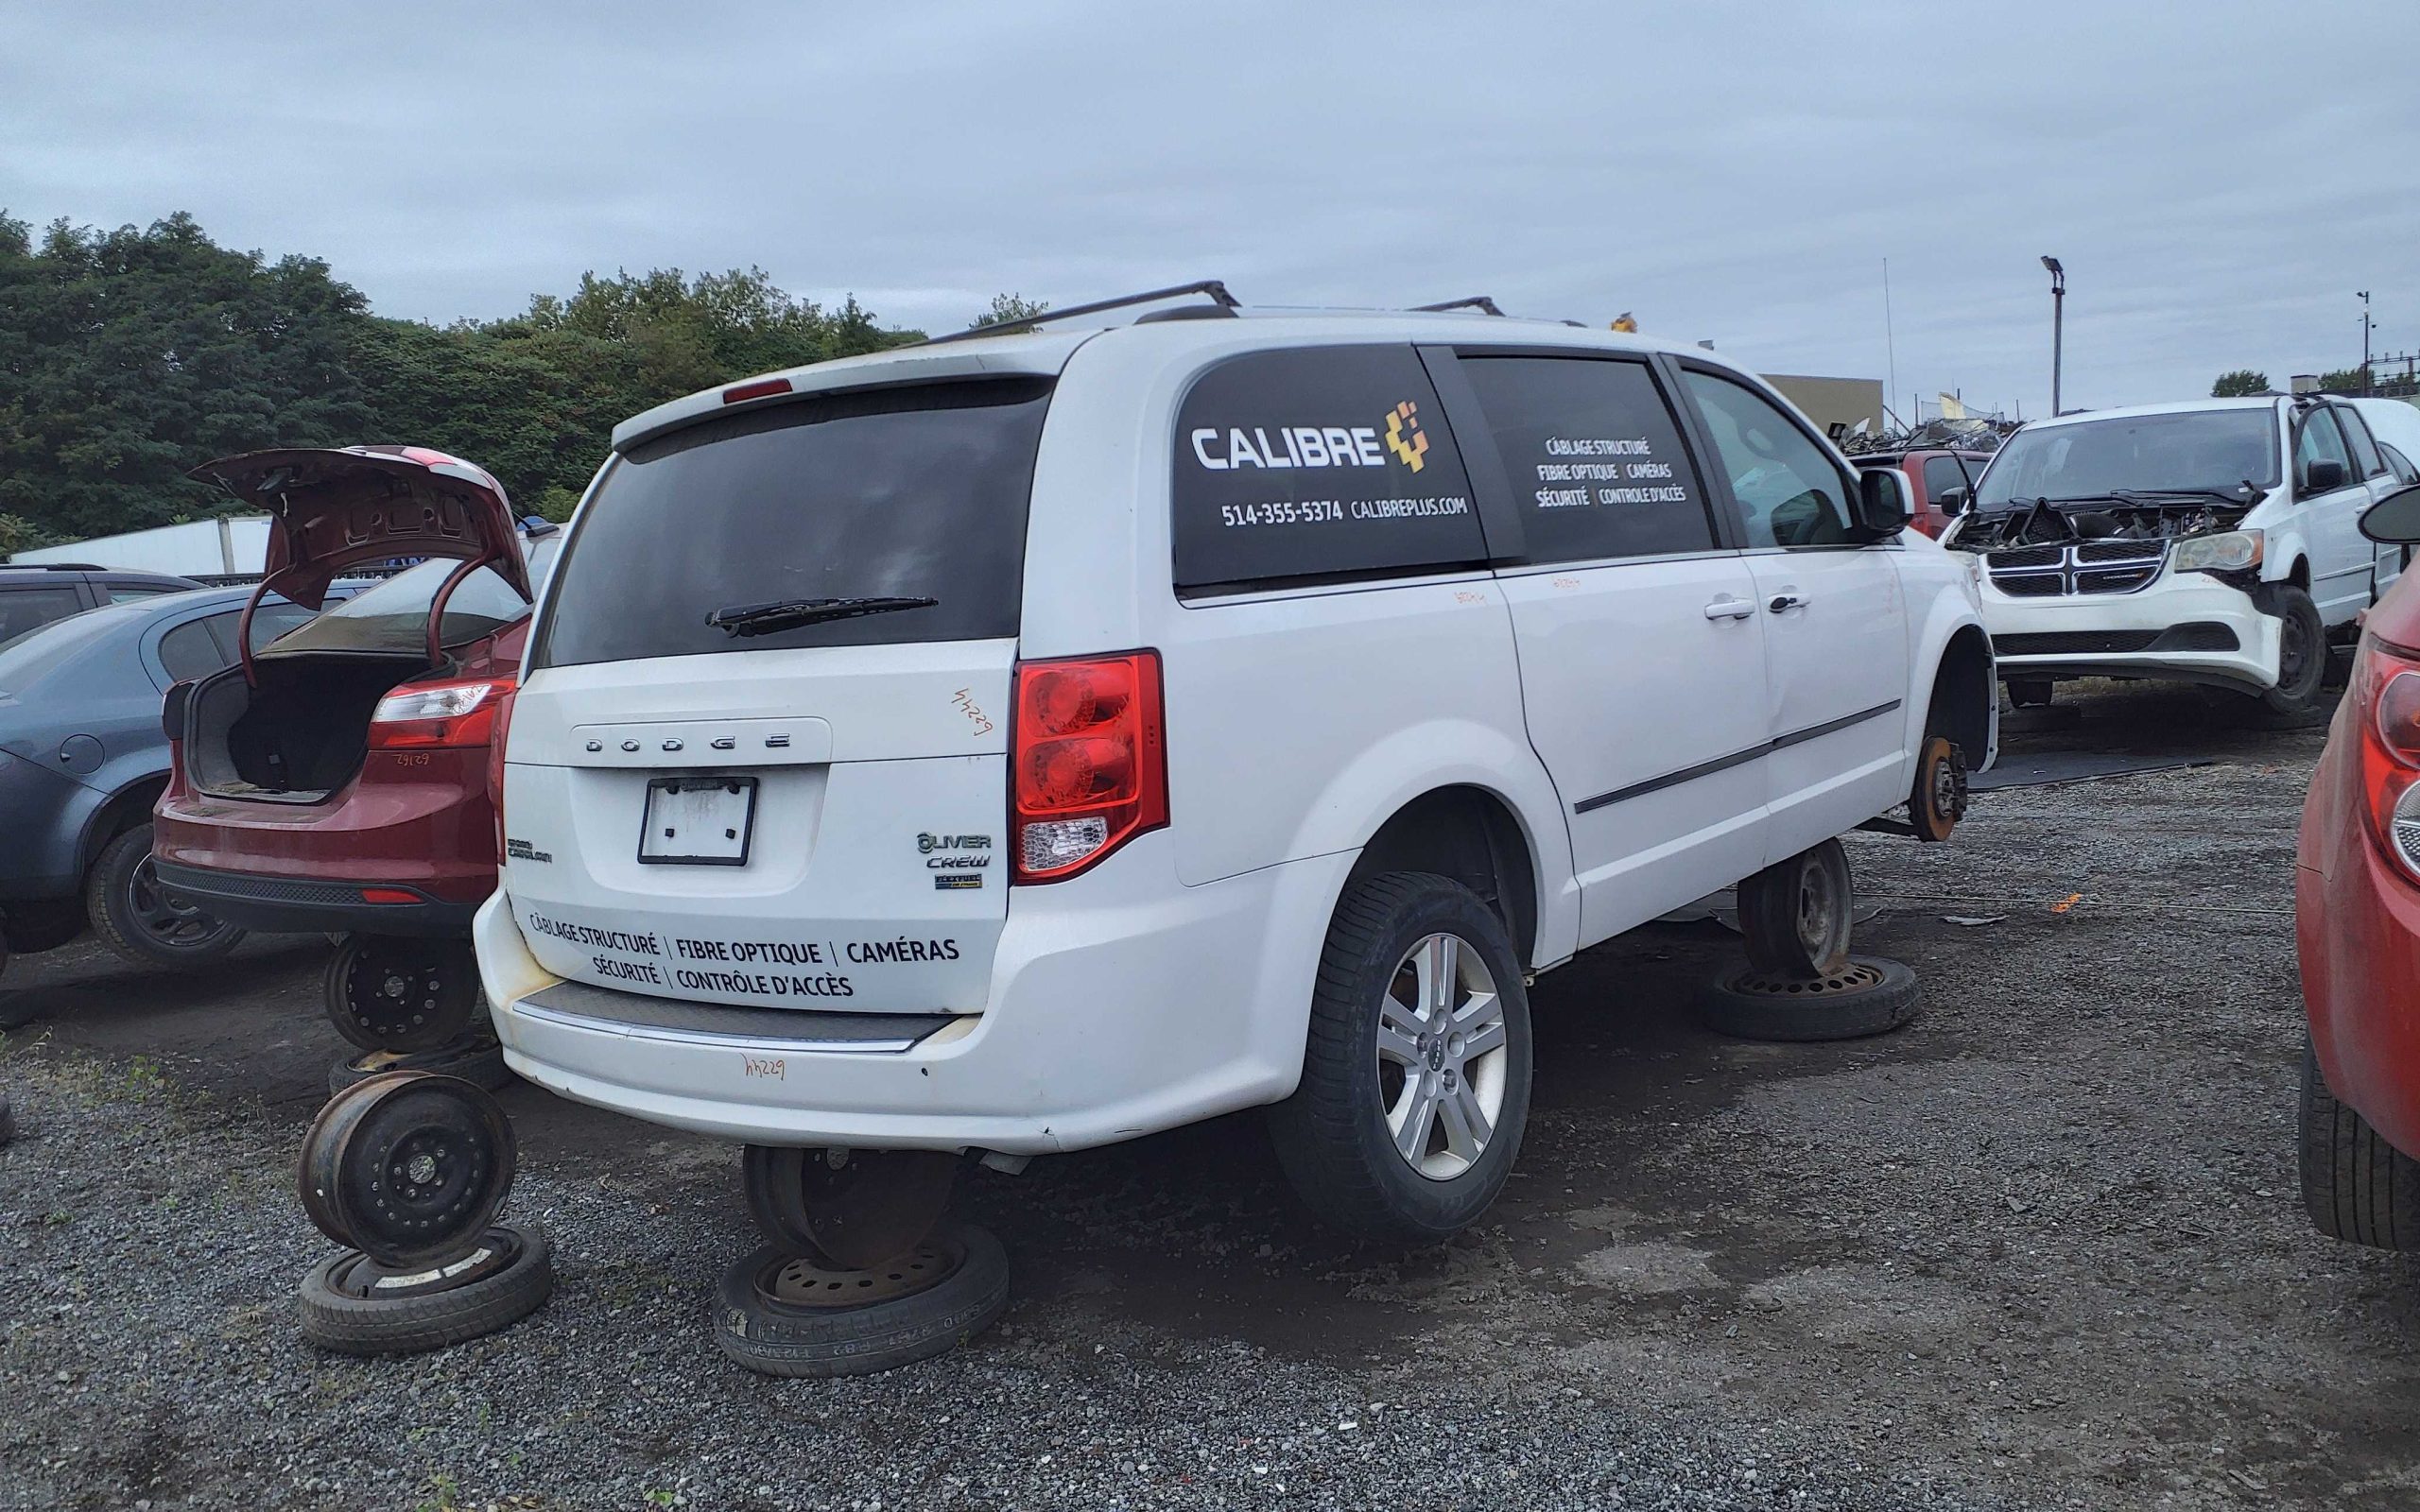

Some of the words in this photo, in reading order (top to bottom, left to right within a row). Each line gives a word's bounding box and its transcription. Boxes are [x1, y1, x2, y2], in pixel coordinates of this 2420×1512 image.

[1191, 427, 1386, 470] CALIBRE
[1593, 436, 1651, 455] STRUCTURÉ
[1537, 464, 1572, 481] FIBRE
[1570, 463, 1618, 481] OPTIQUE
[1626, 460, 1672, 479] CAMÉRAS
[1535, 485, 1590, 507] SÉCURITÉ
[1220, 499, 1343, 526] 514-355-5374
[1350, 497, 1468, 520] CALIBREPLUS.COM
[585, 732, 791, 752] DODGE
[917, 832, 992, 854] OLIVIER
[926, 854, 991, 868] CREW
[529, 912, 579, 943] CÂBLAGE
[578, 926, 661, 955] STRUCTURÉ
[675, 938, 730, 962] FIBRE
[731, 941, 823, 966] OPTIQUE
[846, 936, 960, 964] CAMÉRAS
[592, 954, 662, 985] SÉCURITÉ
[676, 970, 768, 994] CONTRÔLE
[771, 971, 855, 997] D'ACCÈS
